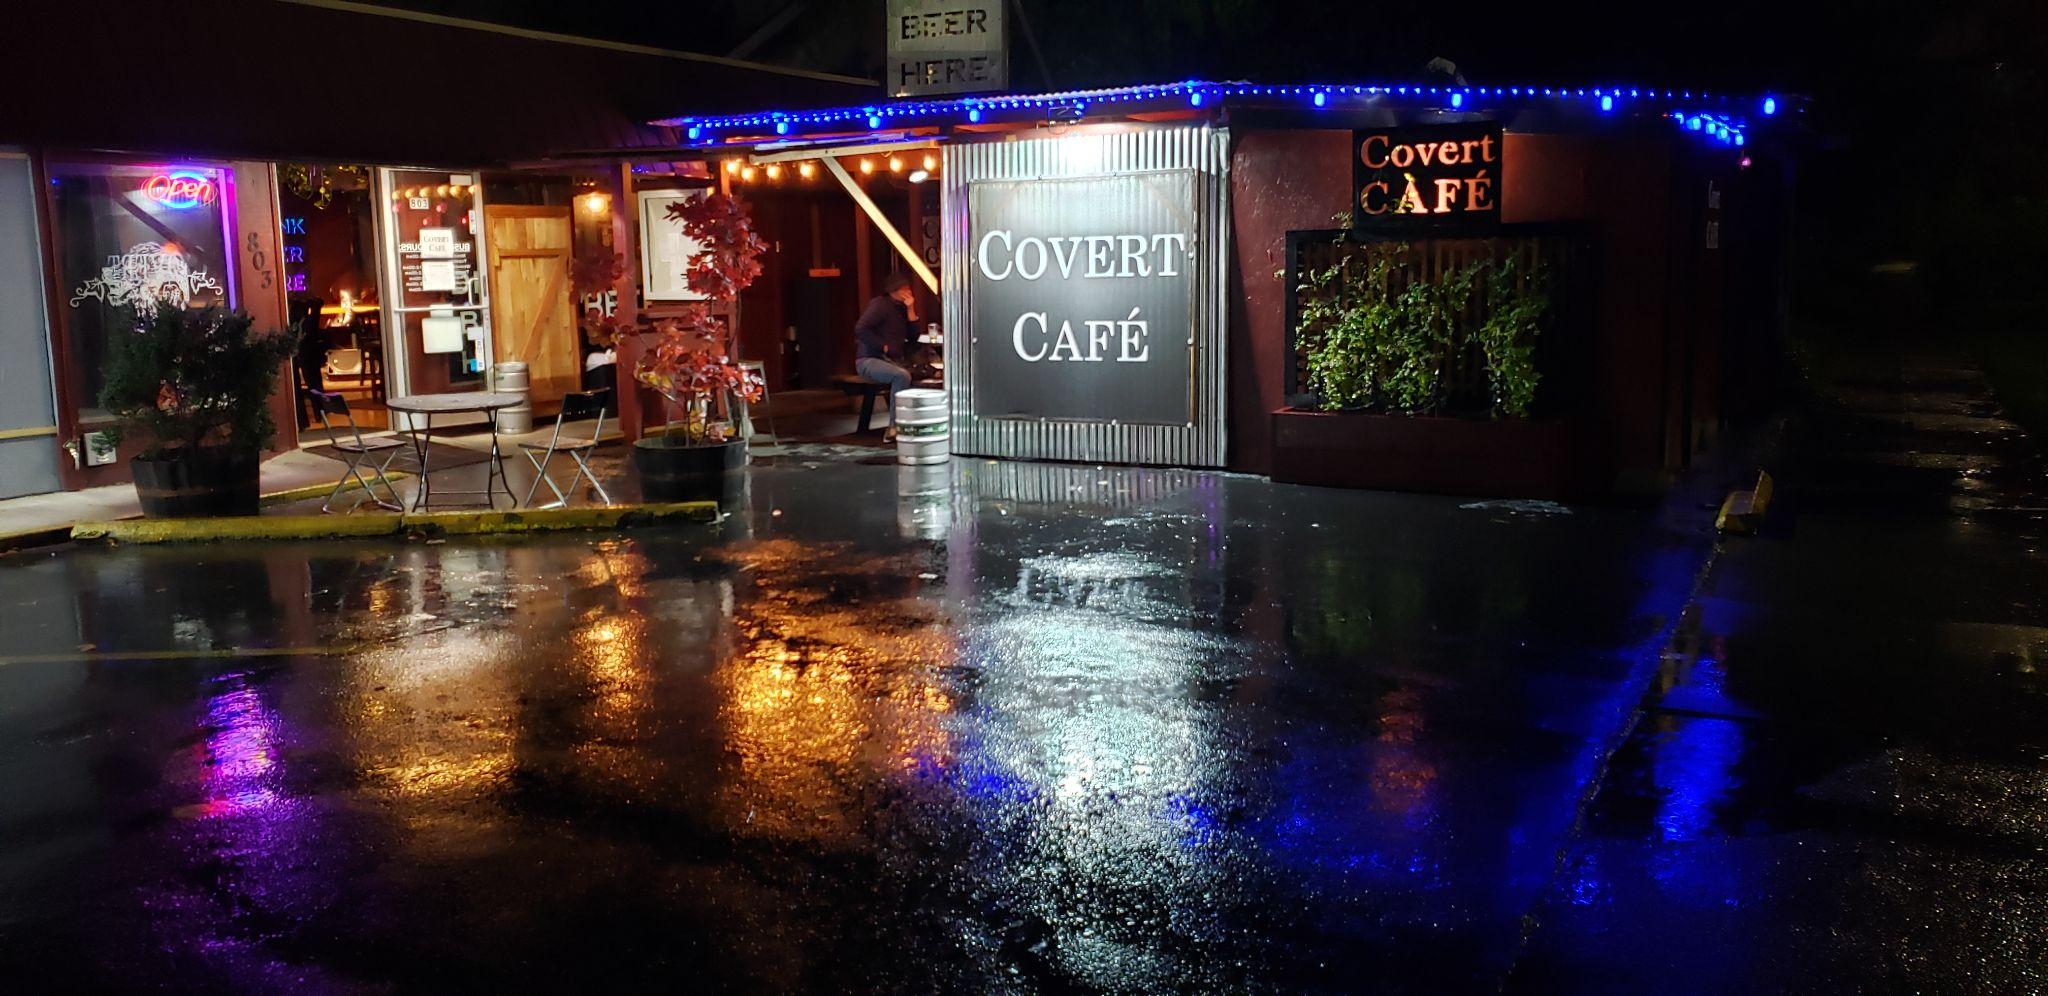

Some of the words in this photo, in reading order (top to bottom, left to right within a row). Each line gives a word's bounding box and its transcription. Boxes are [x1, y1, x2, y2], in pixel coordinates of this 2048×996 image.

[901, 9, 987, 39] BEER
[901, 57, 988, 86] HERE
[1361, 134, 1496, 168] Covert
[147, 175, 211, 203] Open
[410, 198, 429, 208] 803
[247, 232, 272, 289] 803
[978, 230, 1185, 280] COVERT
[1012, 306, 1149, 362] CAFÉ
